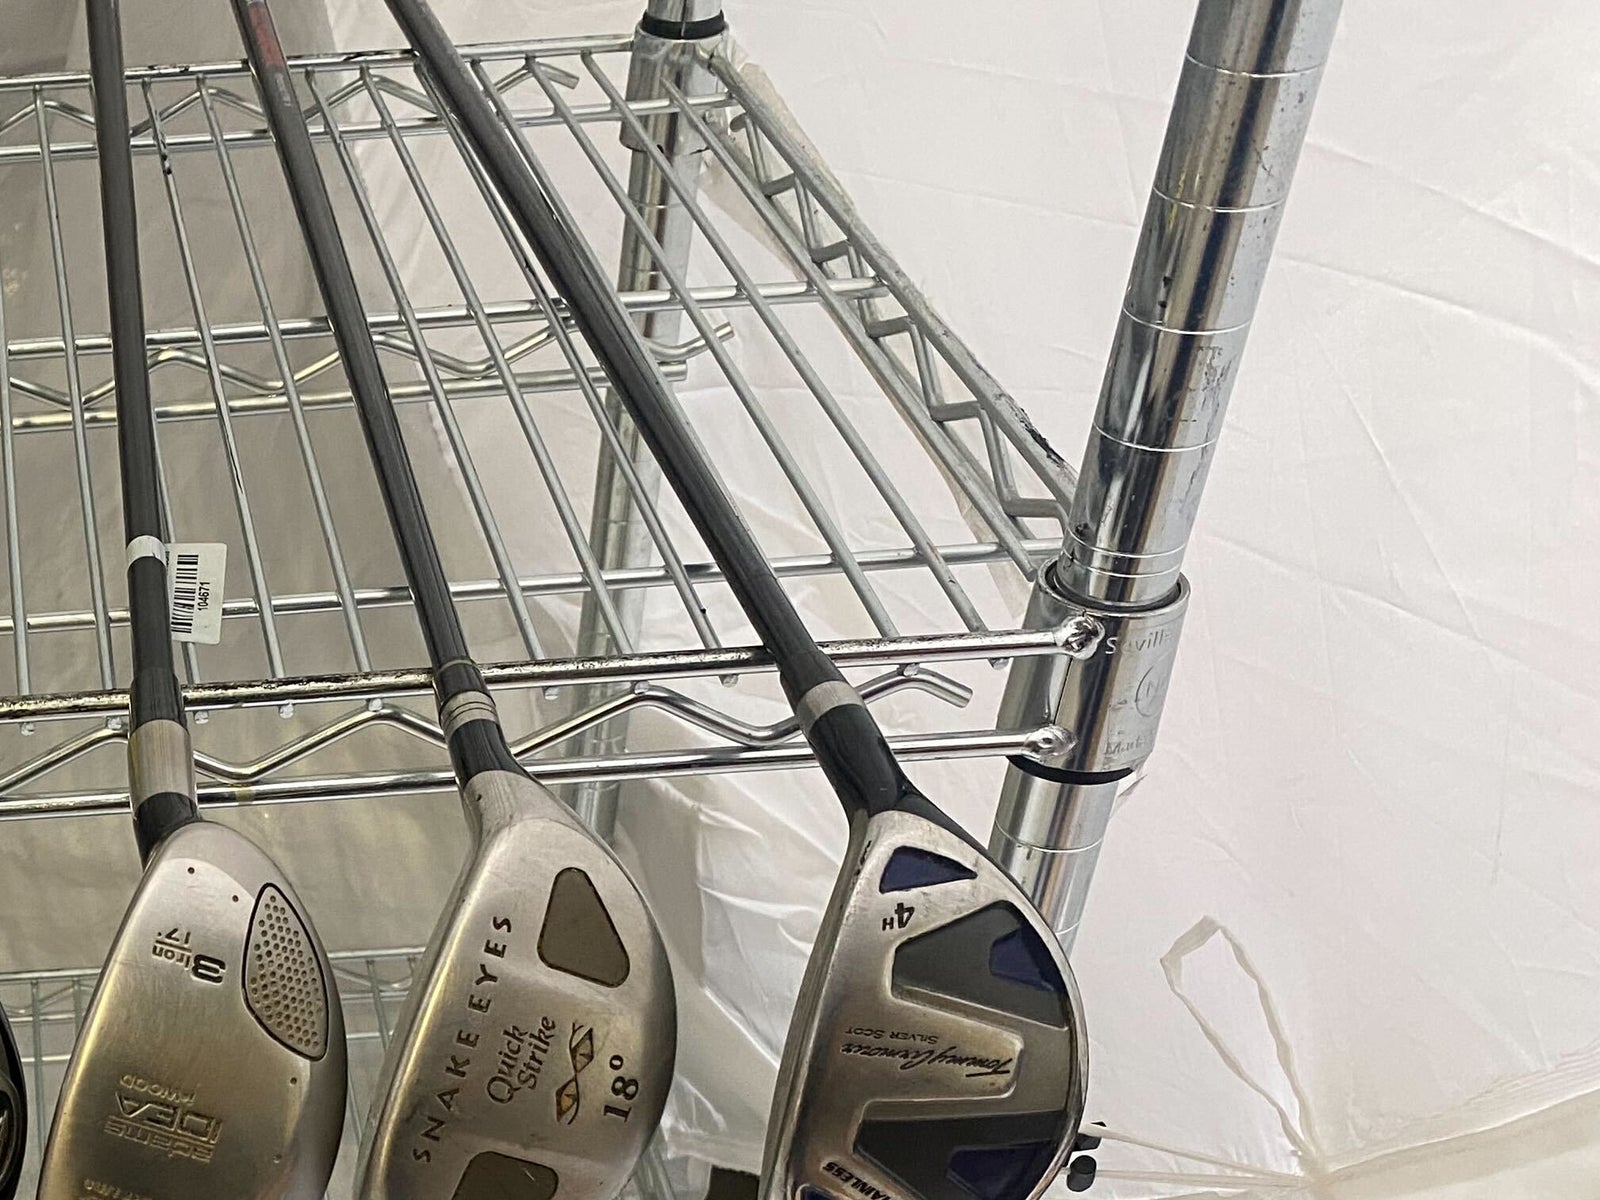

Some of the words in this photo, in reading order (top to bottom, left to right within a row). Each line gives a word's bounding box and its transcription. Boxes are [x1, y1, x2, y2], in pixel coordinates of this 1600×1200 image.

[197, 581, 211, 612] 104671
[151, 944, 191, 970] iron
[190, 953, 227, 985] 3
[412, 1028, 481, 1164] SNAKE
[467, 915, 513, 1014] EYES
[517, 1015, 557, 1090] Strike
[485, 1023, 529, 1105] Quick
[929, 1045, 1013, 1078] Tommy
[114, 1090, 223, 1144] IDEA
